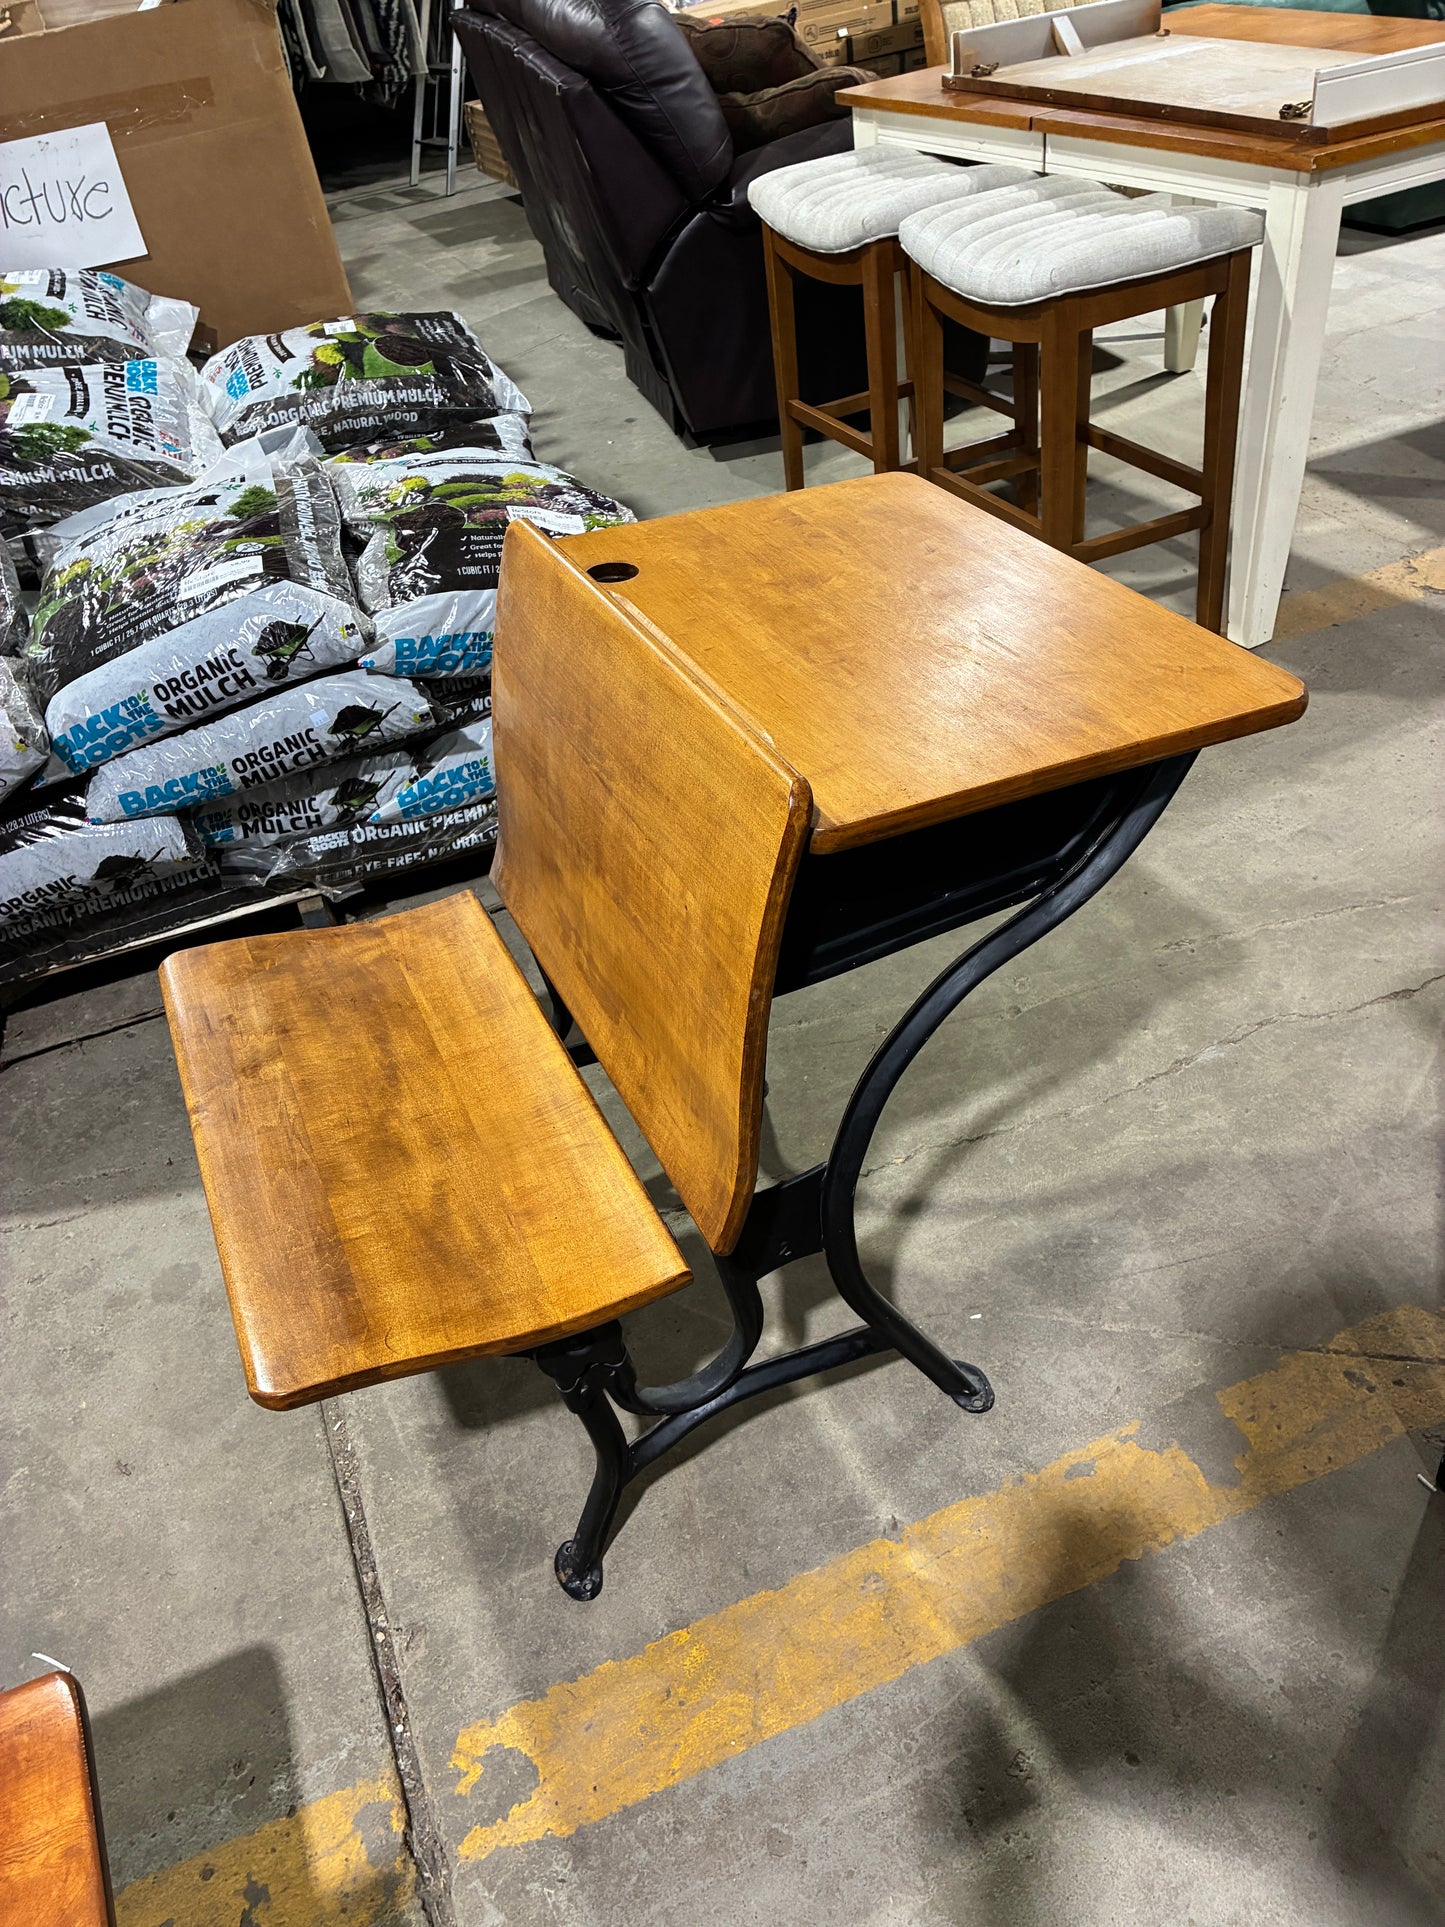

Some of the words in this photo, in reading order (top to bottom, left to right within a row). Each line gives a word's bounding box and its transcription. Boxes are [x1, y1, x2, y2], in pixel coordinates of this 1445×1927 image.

[32, 344, 86, 358] MULCH
[267, 400, 332, 426] ORGANIC
[332, 390, 395, 410] PREMIUM
[396, 388, 443, 405] MULCH
[333, 416, 383, 433] NATURAL
[384, 411, 418, 424] WOOD
[470, 543, 492, 551] Great
[461, 565, 482, 575] CUBIC
[483, 565, 490, 574] FT
[95, 639, 114, 655] CUBIC
[114, 634, 121, 645] FT
[394, 633, 472, 660] BACK
[472, 632, 487, 641] TO
[472, 642, 493, 651] THE
[153, 648, 245, 702] ORGANIC
[394, 652, 493, 675] ROOTS
[164, 668, 257, 719] MULCH
[471, 696, 492, 712] WO
[127, 702, 154, 722] THE
[52, 702, 134, 762] BACK
[120, 695, 140, 712] TO
[66, 713, 165, 774] ROOTS
[231, 727, 319, 774] ORGANIC
[239, 743, 328, 789] MULCH
[468, 767, 490, 780] THE
[118, 772, 206, 814] BACK
[200, 766, 218, 780] TO
[205, 774, 230, 788] THE
[397, 764, 470, 808] BACK
[464, 760, 480, 772] TO
[238, 797, 320, 821] ORGANIC
[401, 776, 495, 819] ROOTS
[242, 813, 323, 839] MULCH
[353, 820, 430, 844] ORGANIC
[308, 839, 350, 852] ROOTS
[0, 875, 77, 916] ORGANIC
[0, 907, 73, 942] ORGANIC
[74, 883, 158, 919] PREMIUM
[161, 860, 220, 893] MULCH
